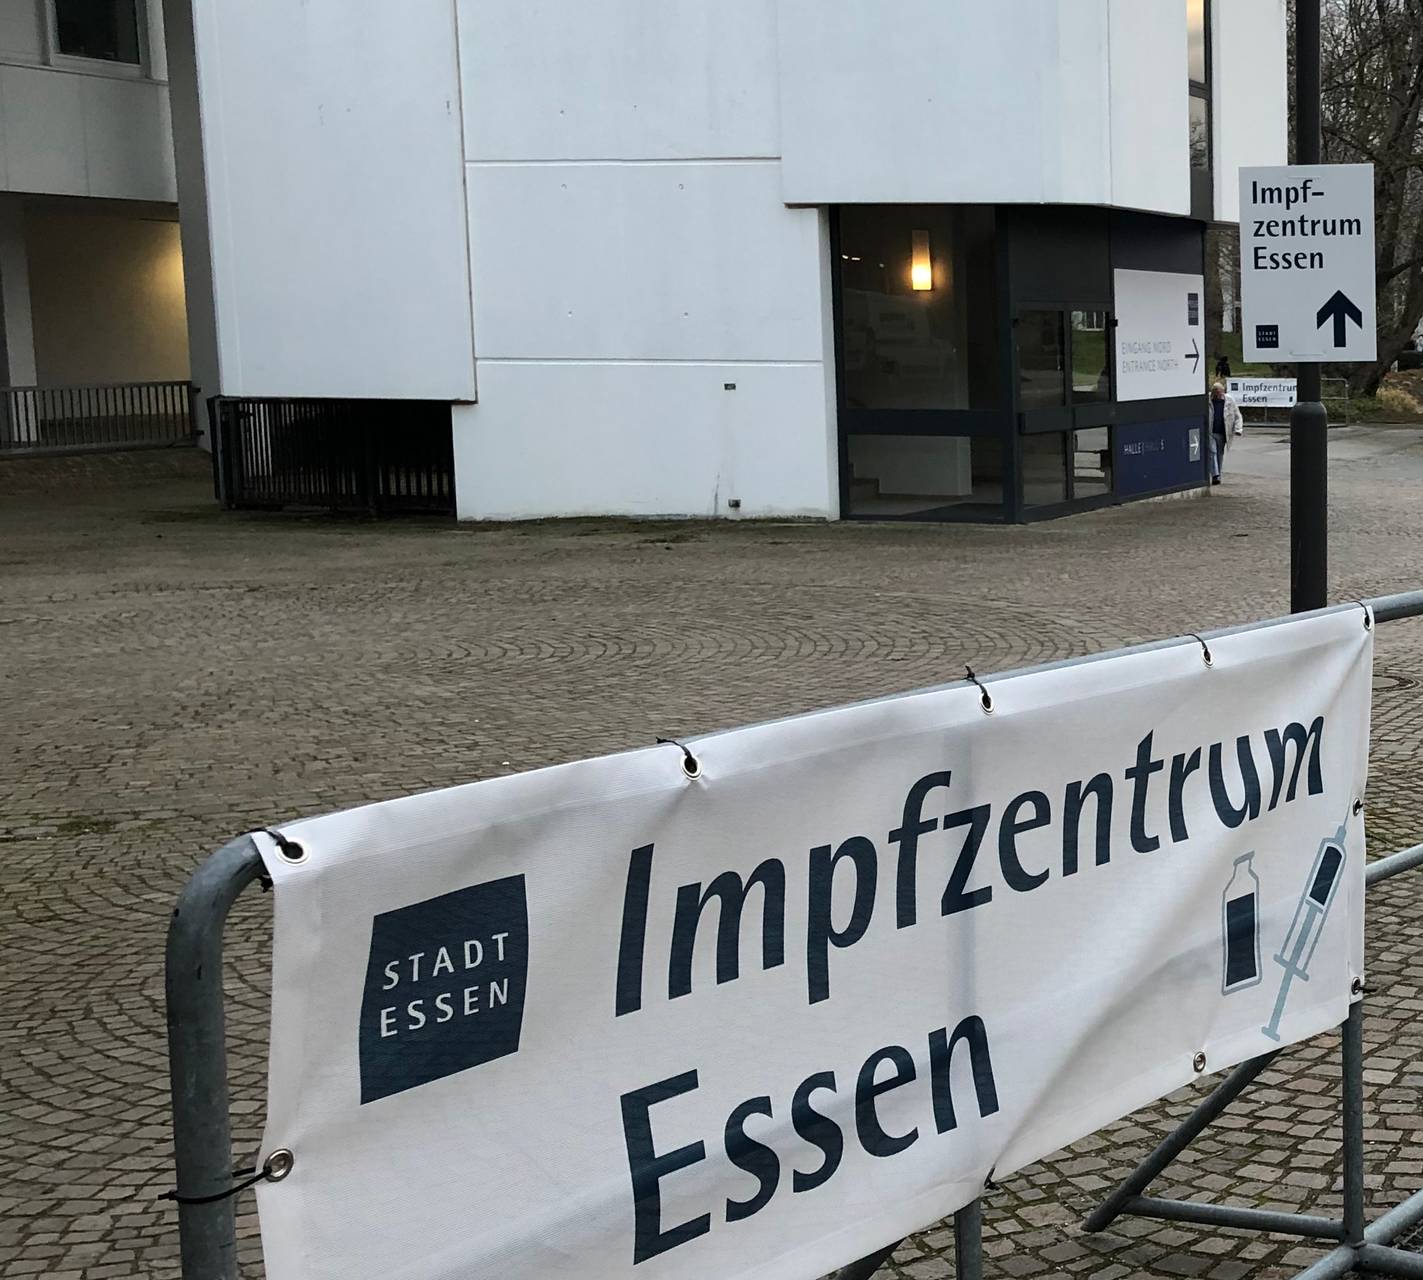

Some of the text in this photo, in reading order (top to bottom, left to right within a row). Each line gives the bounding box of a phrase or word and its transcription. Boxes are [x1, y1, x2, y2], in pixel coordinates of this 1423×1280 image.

[1252, 179, 1325, 211] Impf-
[1253, 214, 1361, 237] zentrum
[1253, 246, 1324, 270] Essen
[1242, 393, 1267, 402] Essen
[615, 715, 1325, 1018] Impfzentrum
[382, 932, 510, 991] STADT
[380, 977, 510, 1039] ESSEN
[620, 1014, 1000, 1266] Essen
